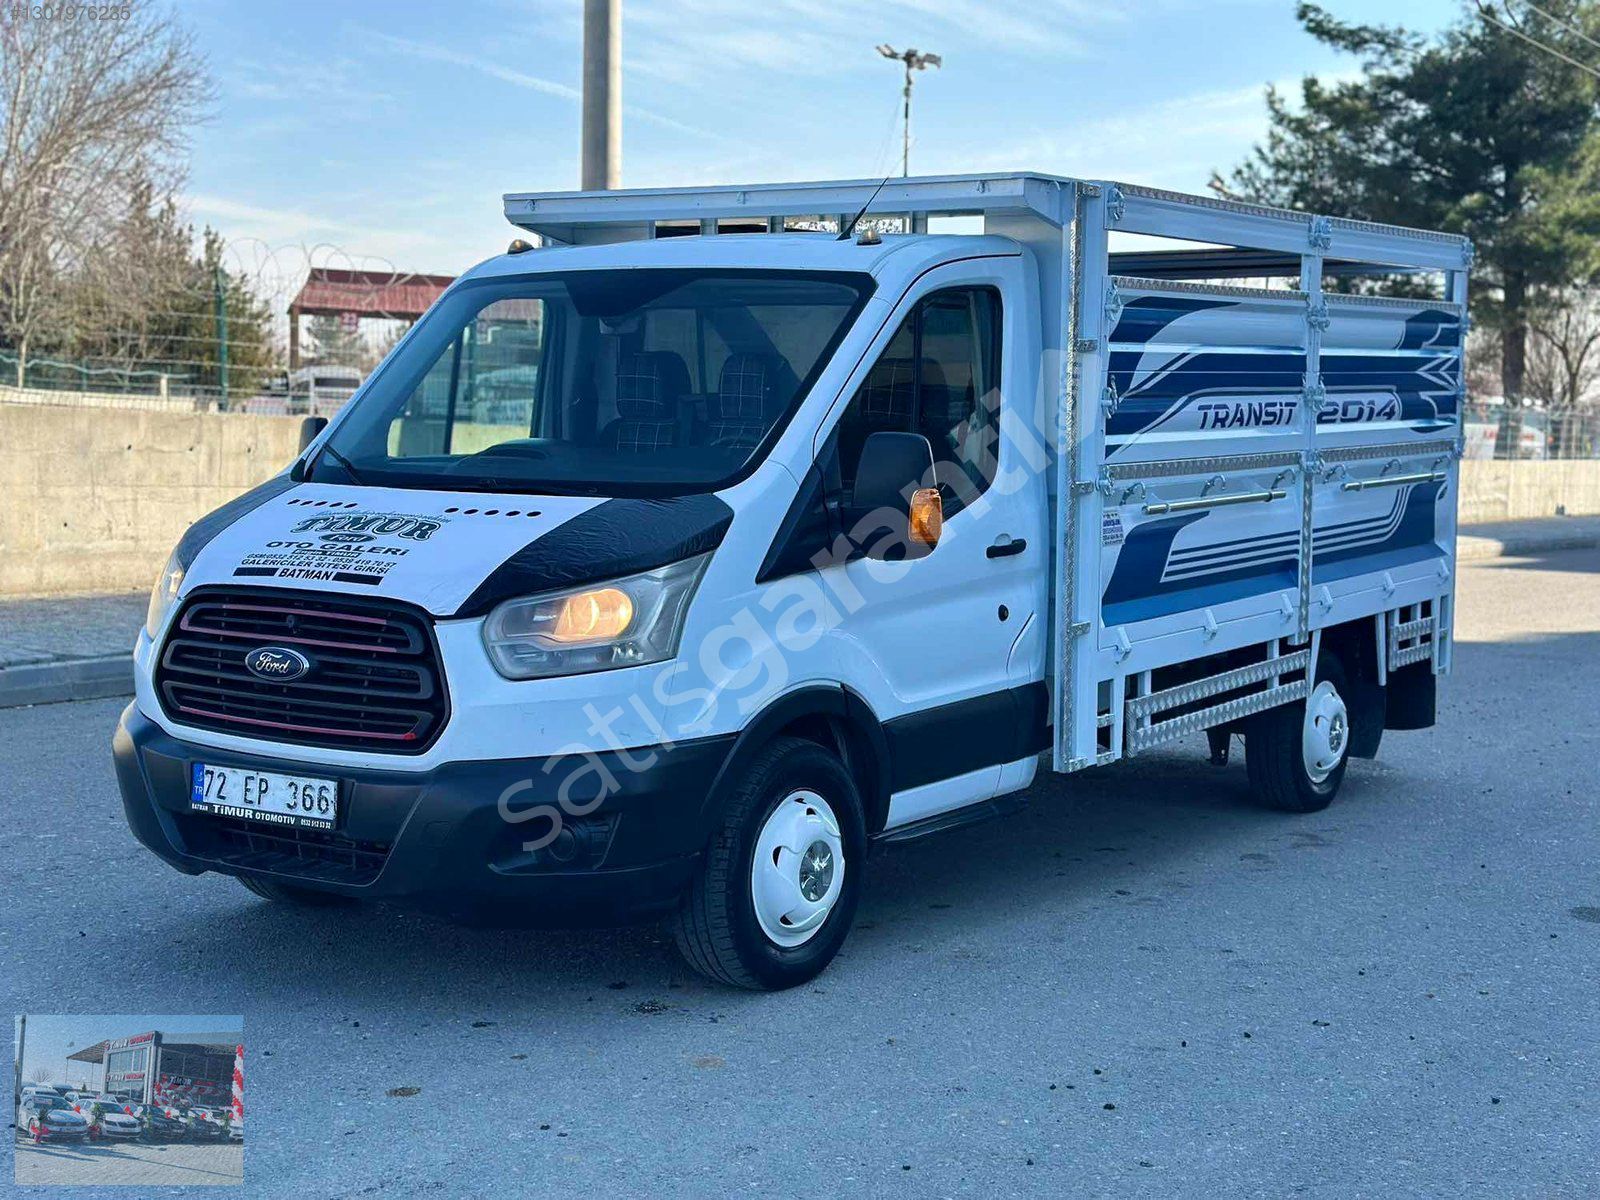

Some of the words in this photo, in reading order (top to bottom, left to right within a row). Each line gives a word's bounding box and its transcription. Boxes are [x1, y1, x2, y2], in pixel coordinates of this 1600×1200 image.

[1316, 399, 1397, 424] 2014
[266, 541, 314, 549] OTO
[278, 568, 334, 581] BATMAN
[255, 651, 291, 674] Ford
[194, 785, 204, 795] TR
[204, 769, 227, 801] 72
[243, 775, 269, 805] EP
[286, 781, 330, 814] 366
